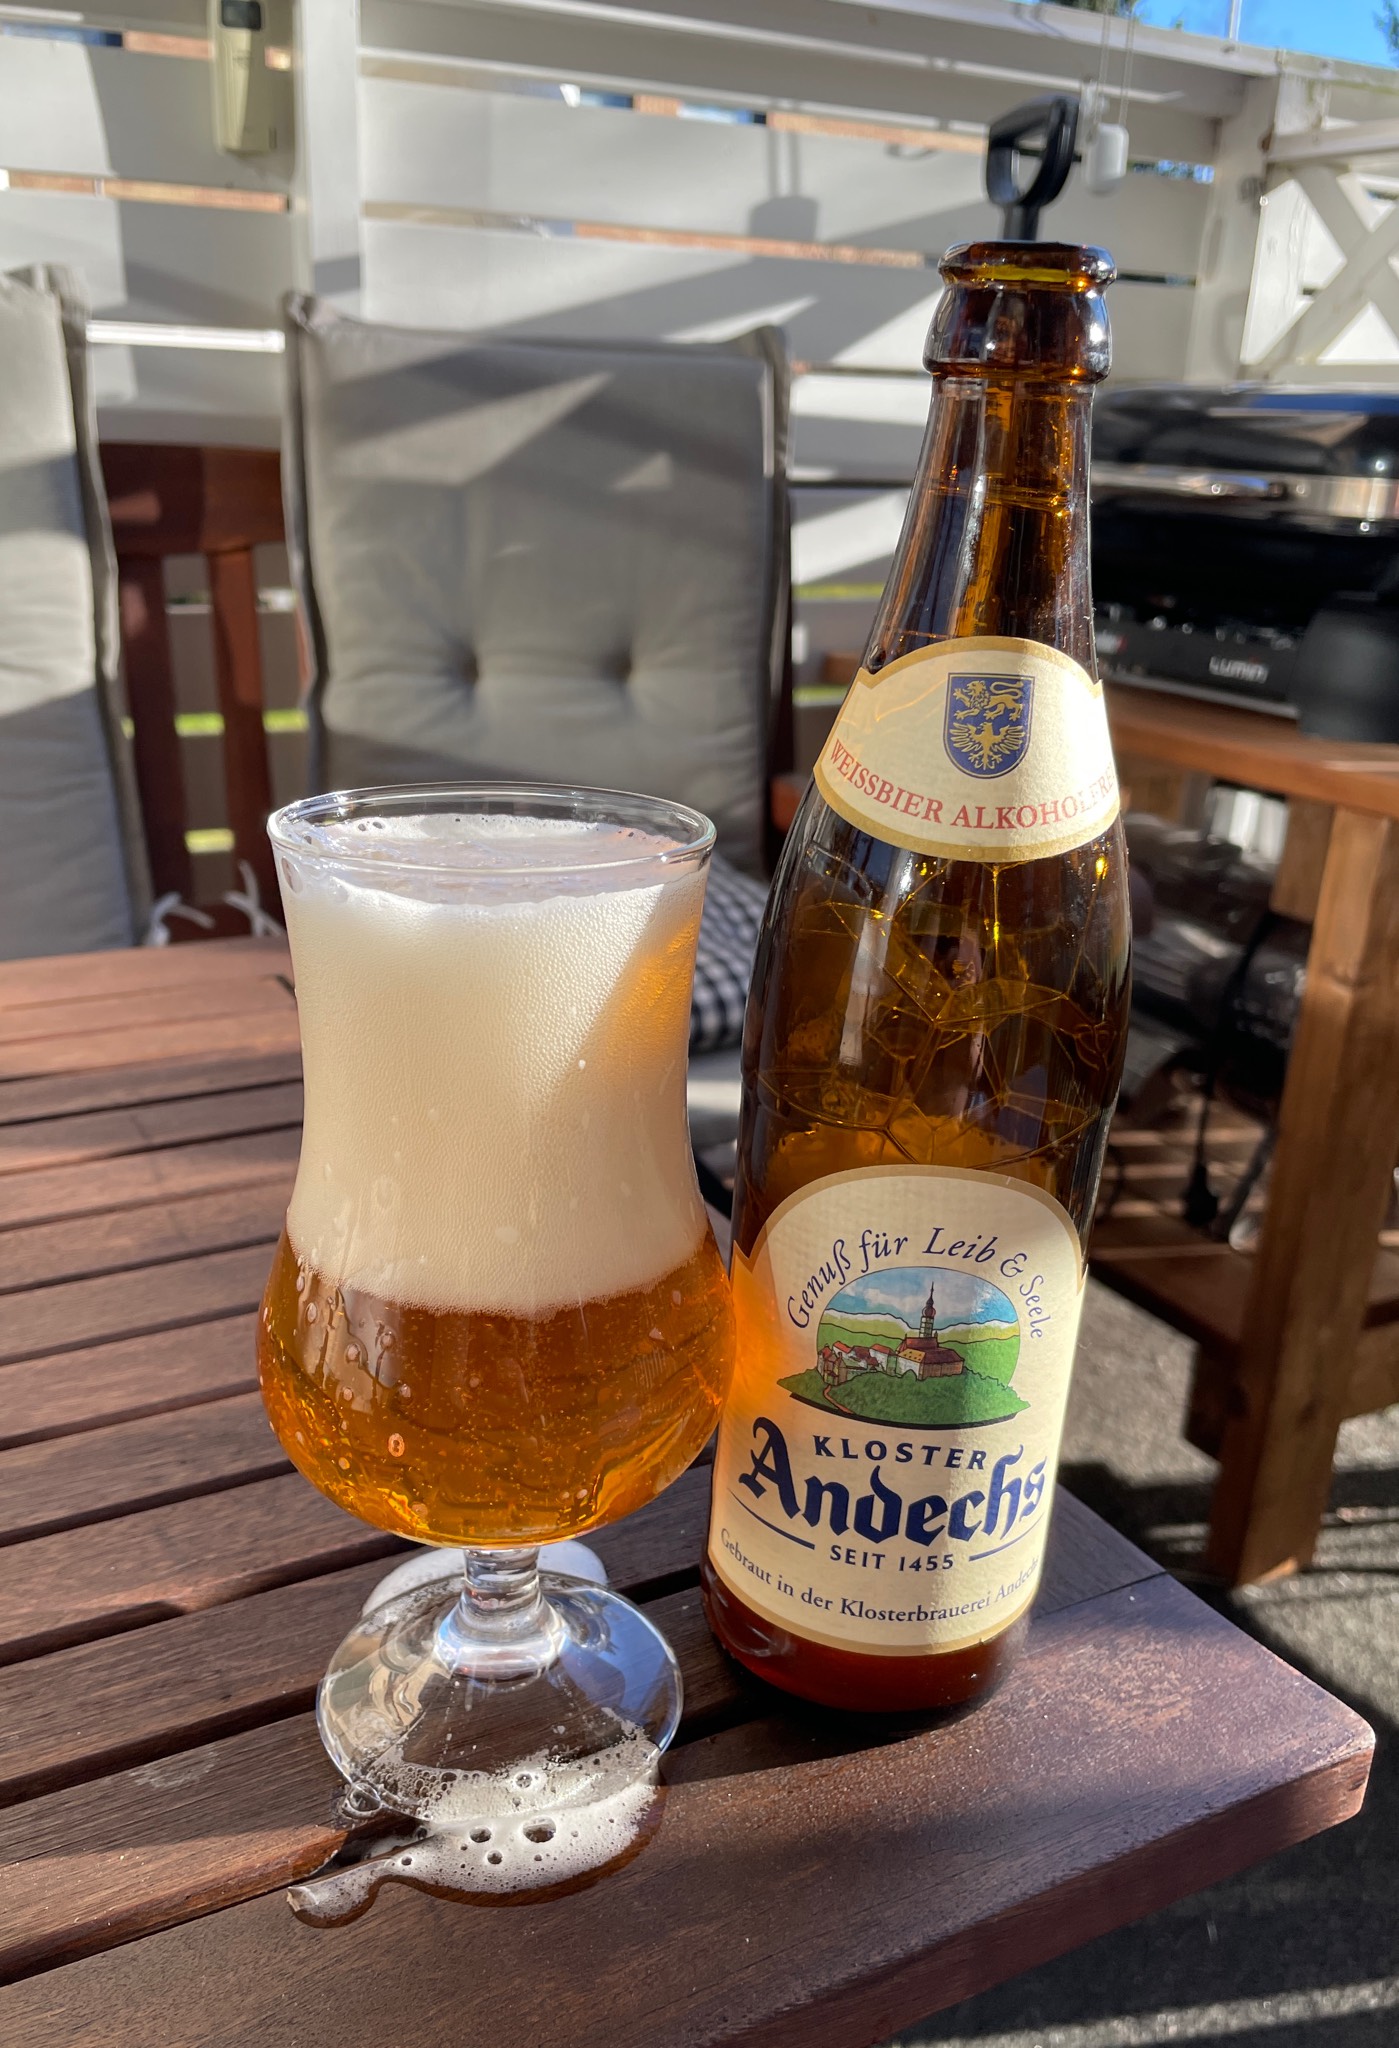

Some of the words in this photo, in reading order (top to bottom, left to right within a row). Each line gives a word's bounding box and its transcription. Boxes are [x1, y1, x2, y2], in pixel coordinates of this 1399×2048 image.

[829, 738, 944, 824] WEISSBIER
[950, 761, 1115, 830] ALKOHOLFRE
[787, 1239, 851, 1329] Genuß
[858, 1229, 909, 1273] für
[922, 1227, 998, 1263] Leib
[999, 1252, 1027, 1278] &
[1019, 1274, 1051, 1339] Seele
[738, 1416, 1048, 1546] Andechs
[812, 1435, 987, 1471] KLOSTER
[720, 1528, 772, 1585] Gebraut
[777, 1574, 794, 1597] in
[800, 1587, 833, 1611] der
[840, 1590, 992, 1623] Klosterbrauerei
[829, 1544, 886, 1569] SEIT
[898, 1554, 954, 1572] 1455
